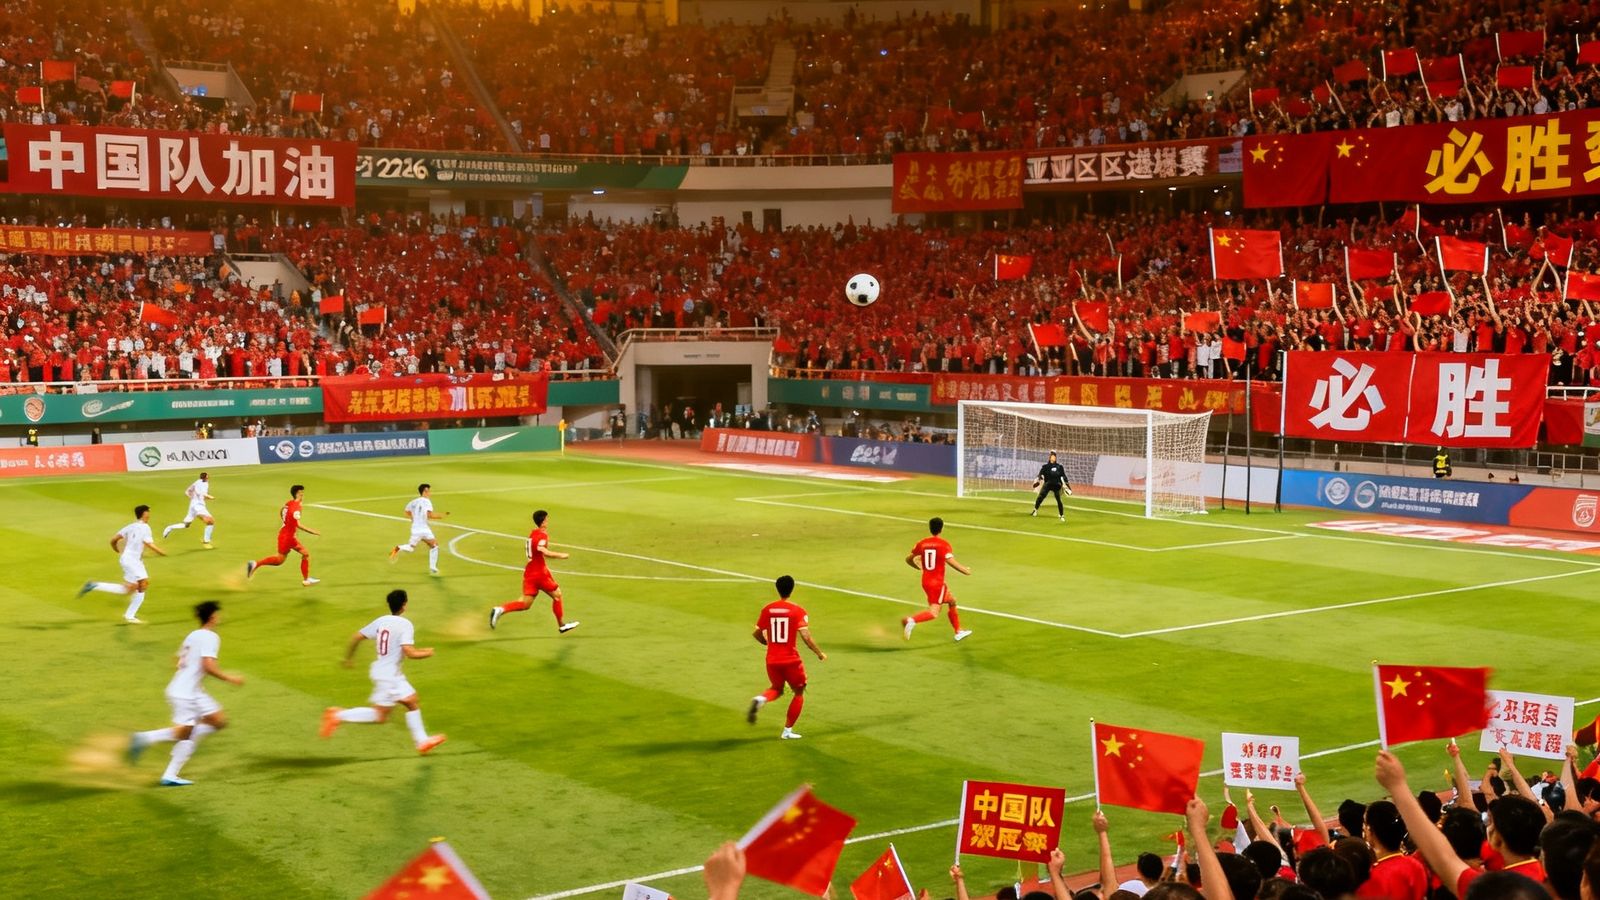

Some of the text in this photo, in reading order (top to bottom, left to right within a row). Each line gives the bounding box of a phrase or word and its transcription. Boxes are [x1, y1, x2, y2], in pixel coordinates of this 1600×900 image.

[28, 130, 335, 199] 中国队加油
[770, 617, 789, 643] 10
[973, 789, 1055, 828] 中国队
